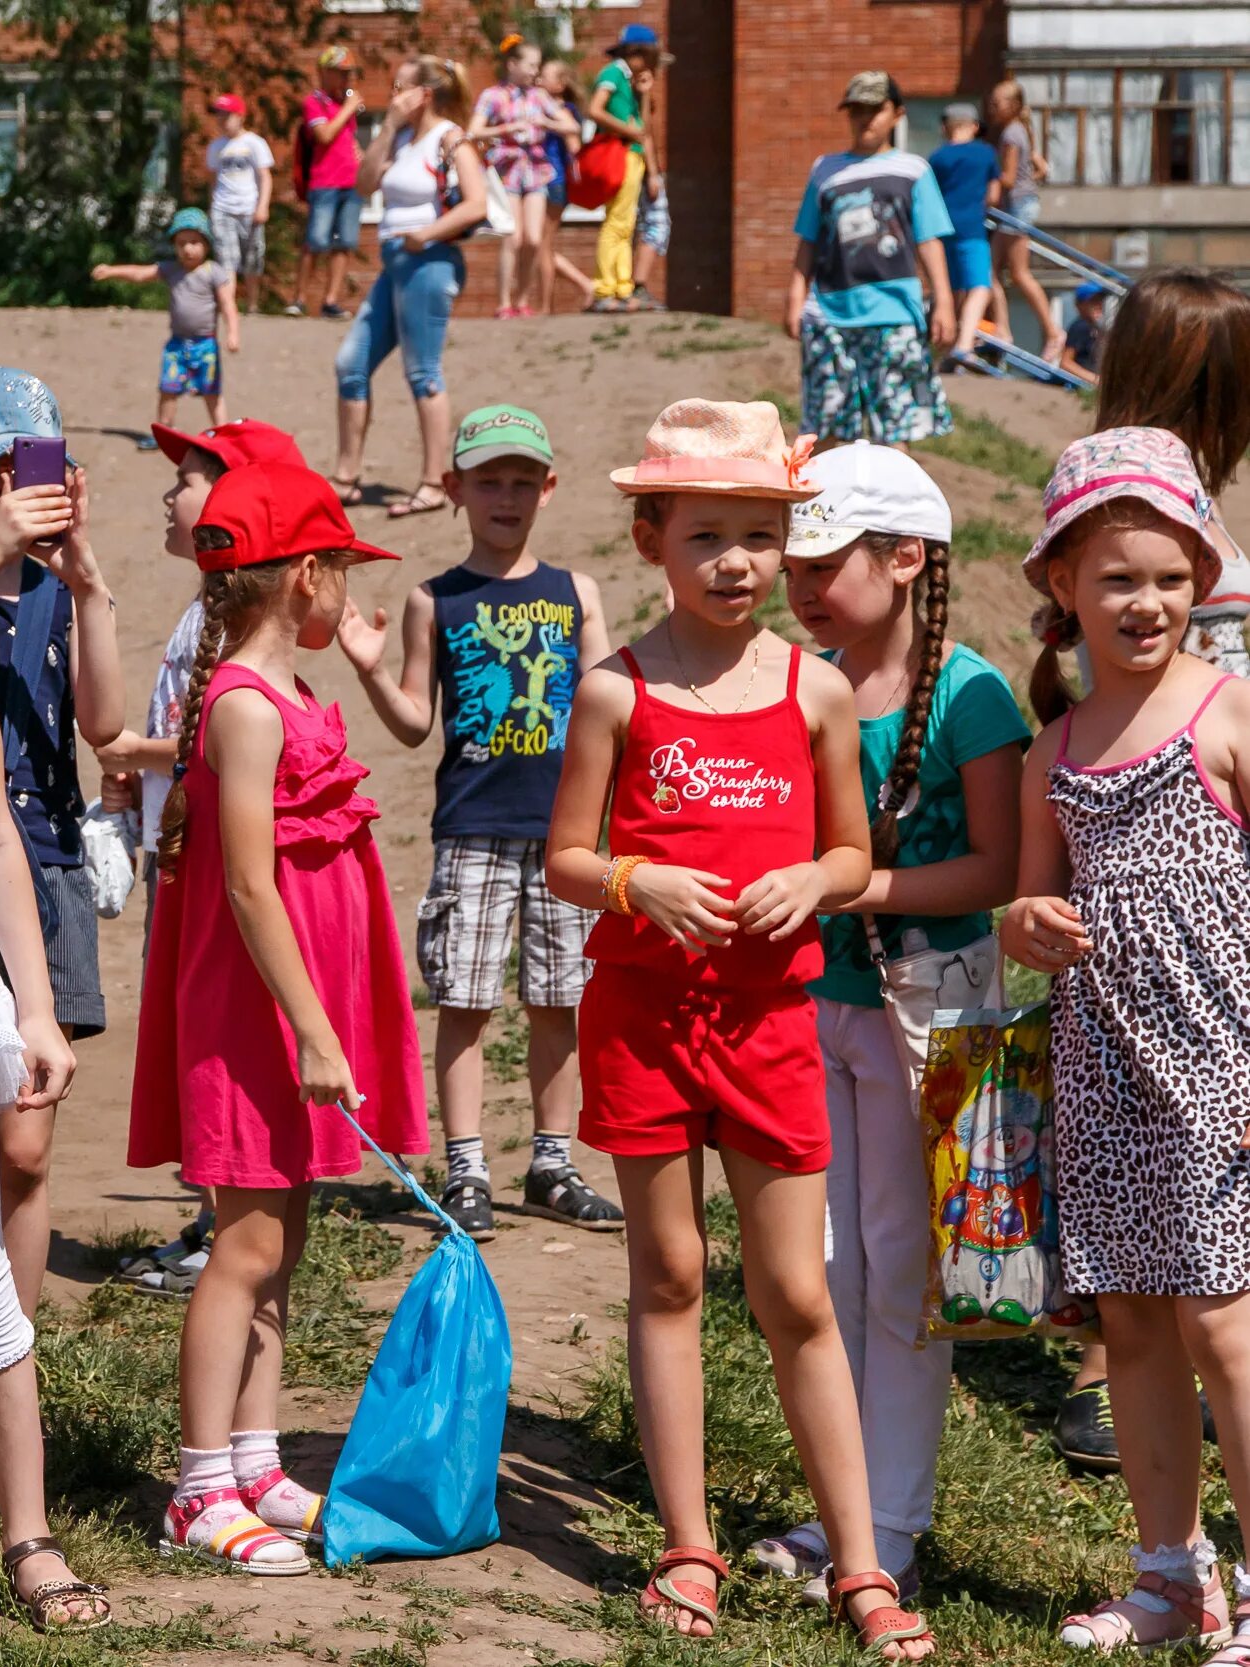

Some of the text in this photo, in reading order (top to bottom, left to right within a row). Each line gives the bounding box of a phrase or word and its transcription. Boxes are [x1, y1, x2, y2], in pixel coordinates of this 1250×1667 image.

[499, 599, 574, 636] CROCODILE
[548, 643, 577, 711] TRTLE
[490, 719, 548, 757] GECKO
[682, 766, 792, 804] Strawberry
[710, 788, 766, 808] sorbet
